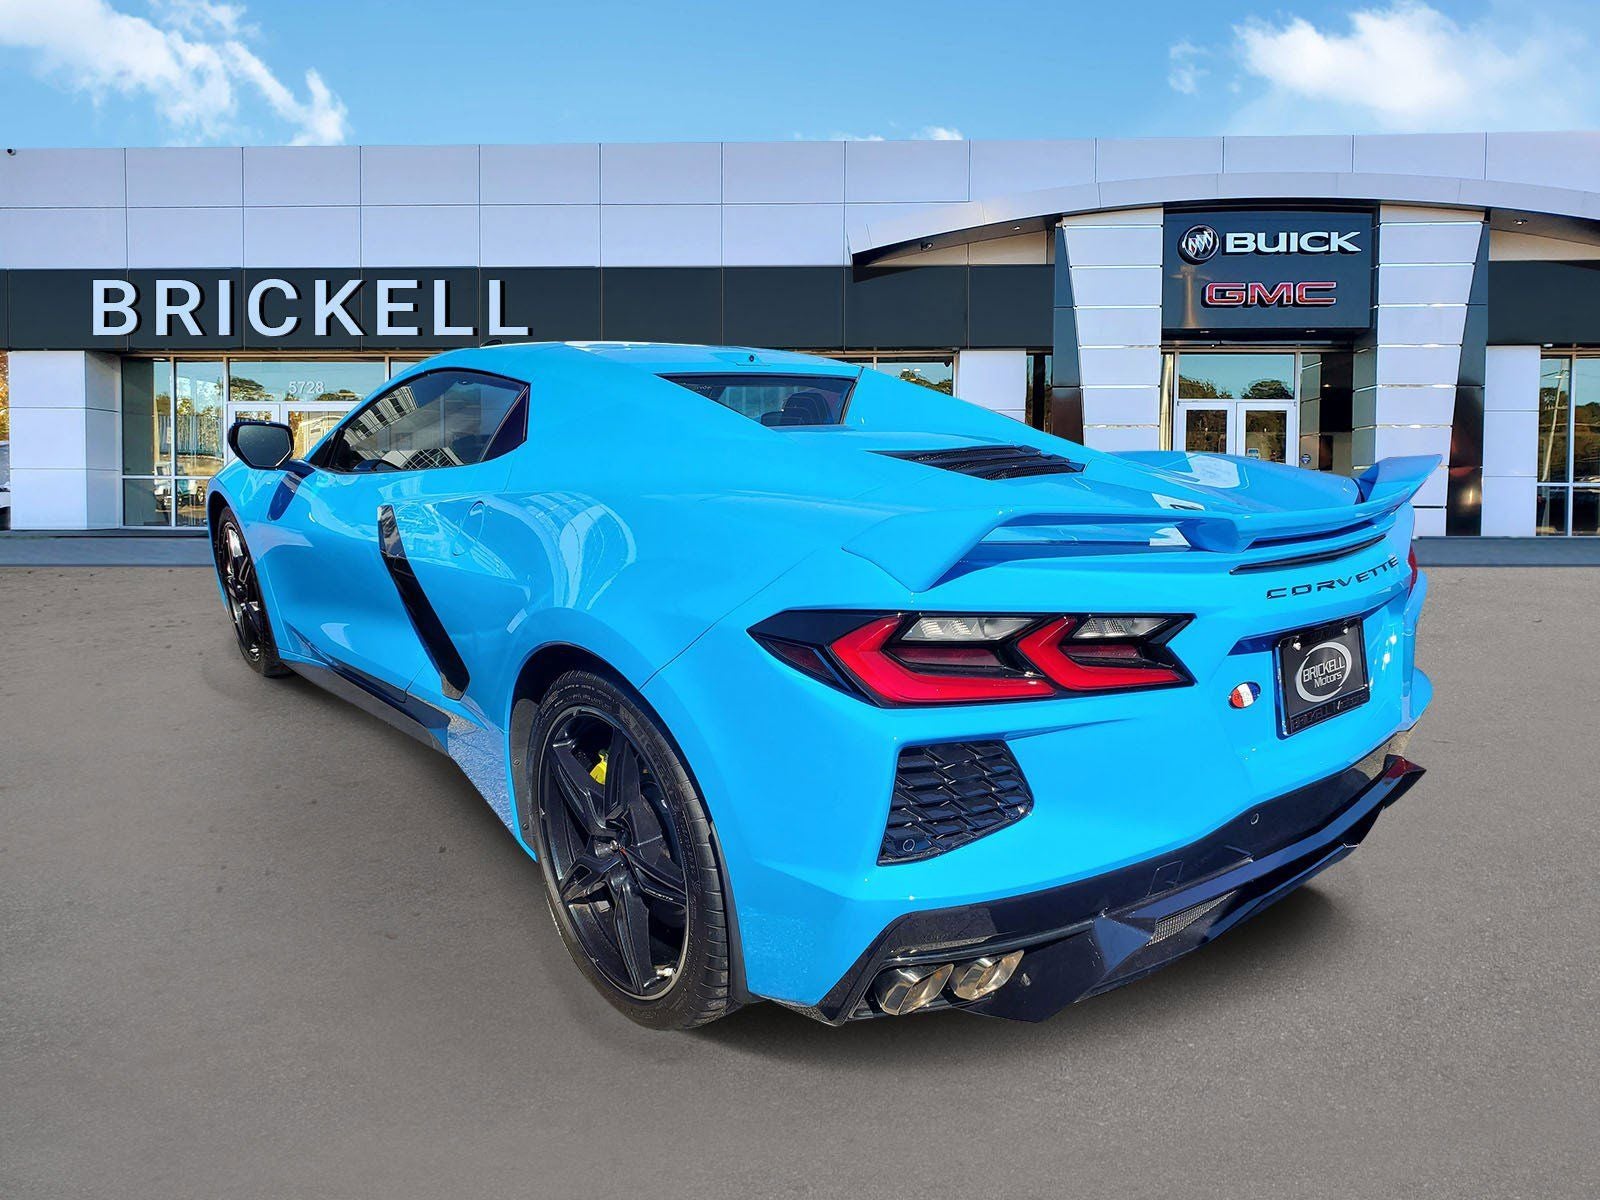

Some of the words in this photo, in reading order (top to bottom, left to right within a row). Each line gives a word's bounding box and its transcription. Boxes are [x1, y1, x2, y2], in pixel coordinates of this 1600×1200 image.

[1225, 231, 1362, 253] BUICK
[1205, 281, 1337, 306] GMC
[92, 278, 529, 337] BRICKELL
[288, 381, 324, 394] 5728
[1266, 556, 1399, 599] CORVETTE
[1302, 656, 1346, 682] BRICKELL
[1314, 671, 1343, 688] Motors
